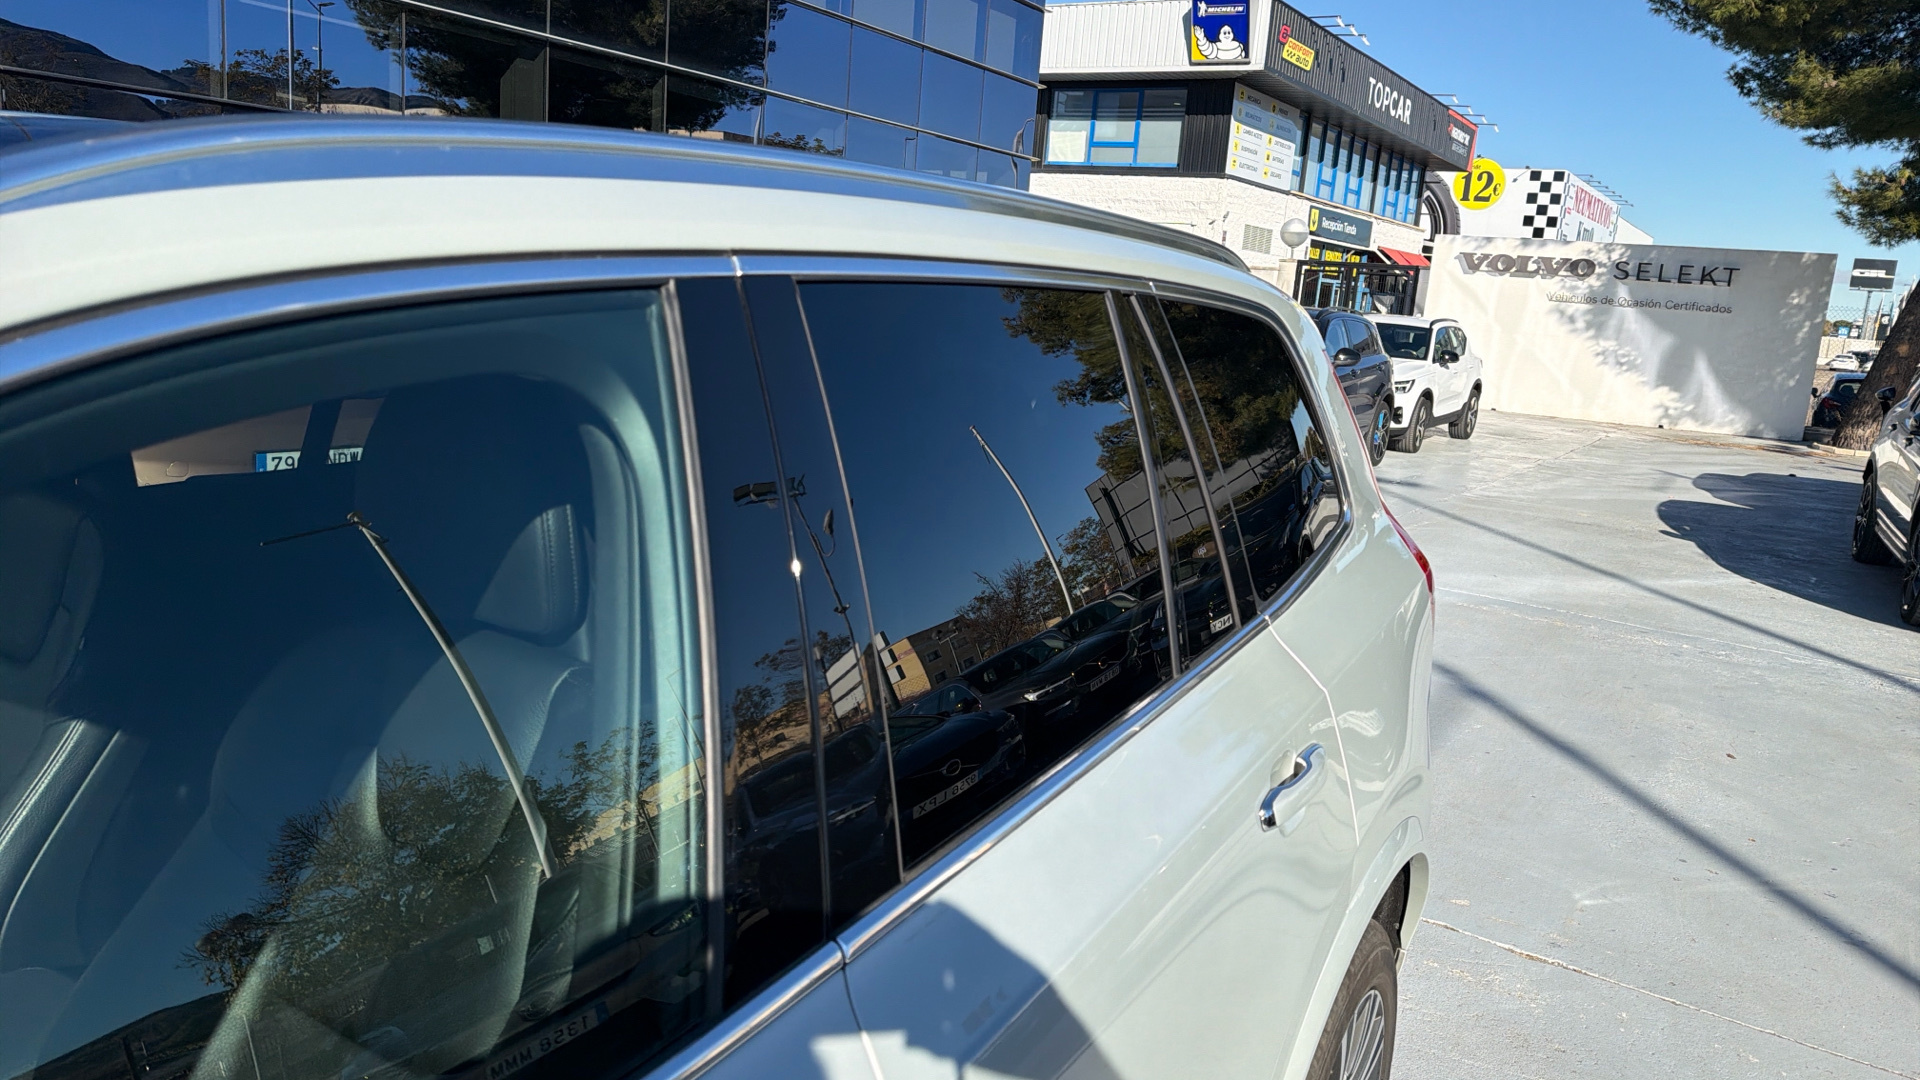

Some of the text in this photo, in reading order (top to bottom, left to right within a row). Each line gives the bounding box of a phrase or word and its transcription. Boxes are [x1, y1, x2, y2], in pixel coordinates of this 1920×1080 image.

[1295, 54, 1310, 68] auto
[1369, 76, 1411, 125] TOPCAR
[1321, 216, 1357, 236] Recepción Tienda
[1458, 251, 1740, 287] VOLVO SELEKT
[1600, 295, 1614, 306] de
[1617, 296, 1662, 309] Ocasión
[1664, 300, 1732, 314] Certificados
